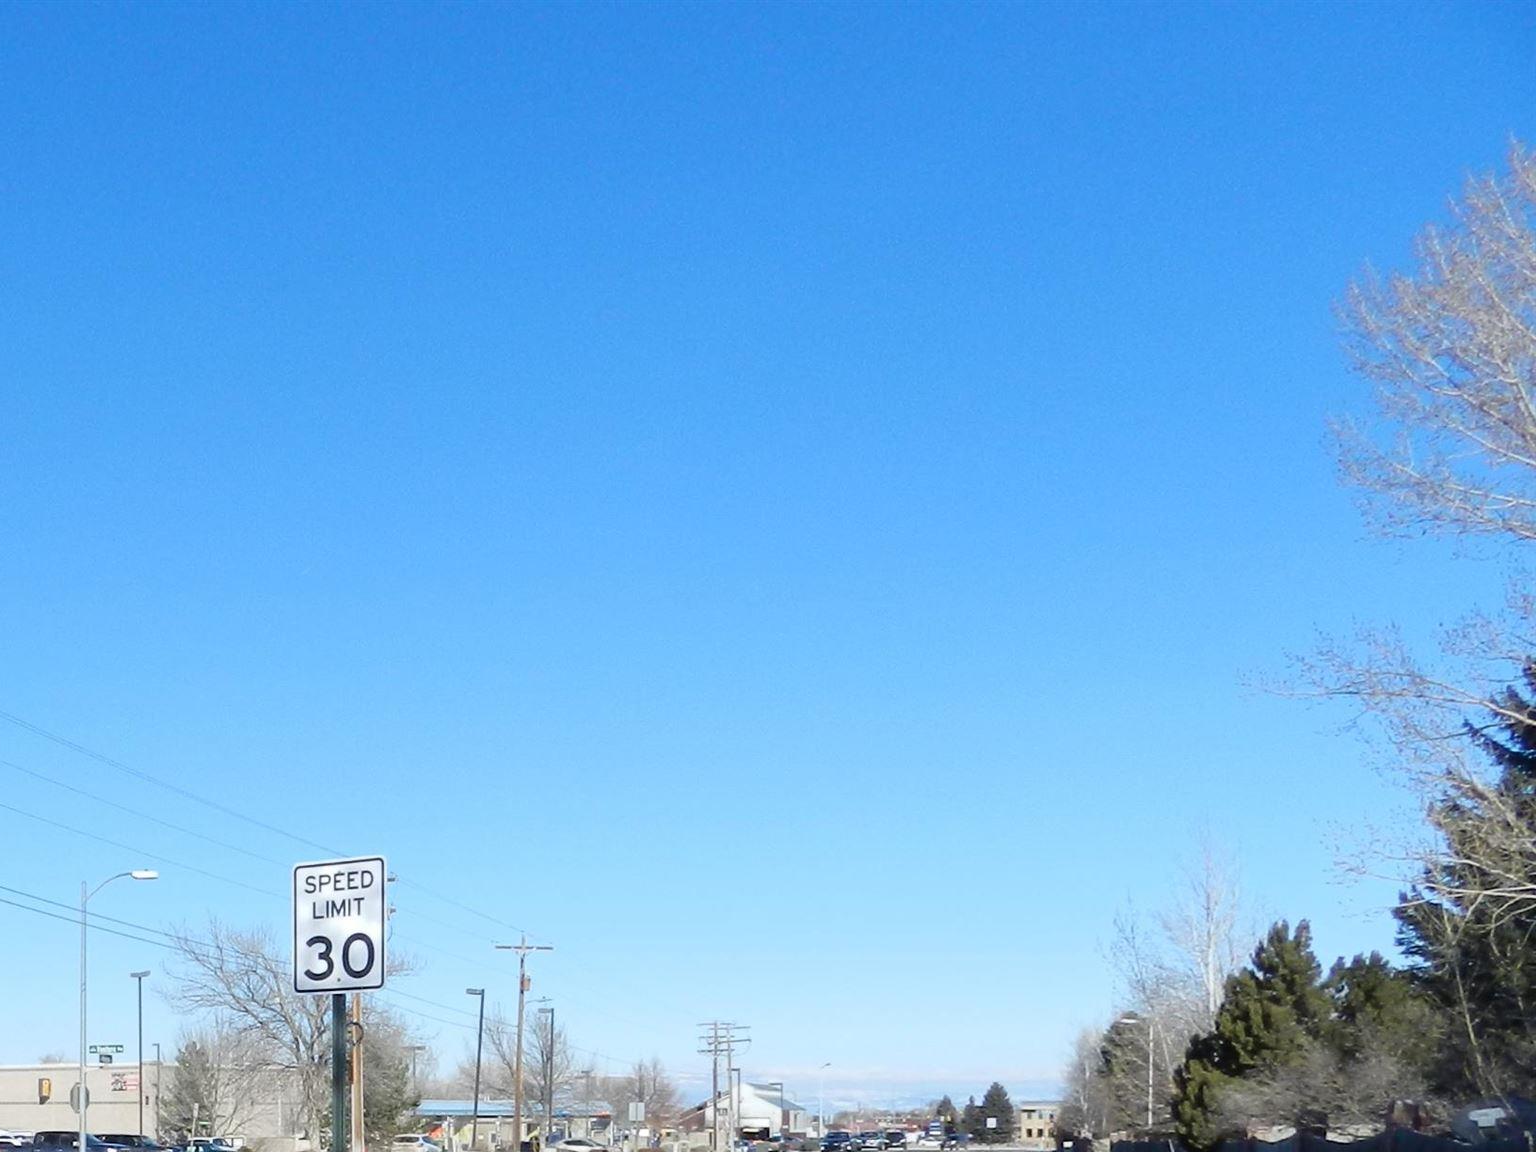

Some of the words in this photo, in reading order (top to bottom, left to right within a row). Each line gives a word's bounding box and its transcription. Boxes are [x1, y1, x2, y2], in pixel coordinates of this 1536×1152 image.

[304, 870, 374, 894] SPEED
[312, 897, 365, 919] LIMIT
[304, 932, 375, 981] 30
